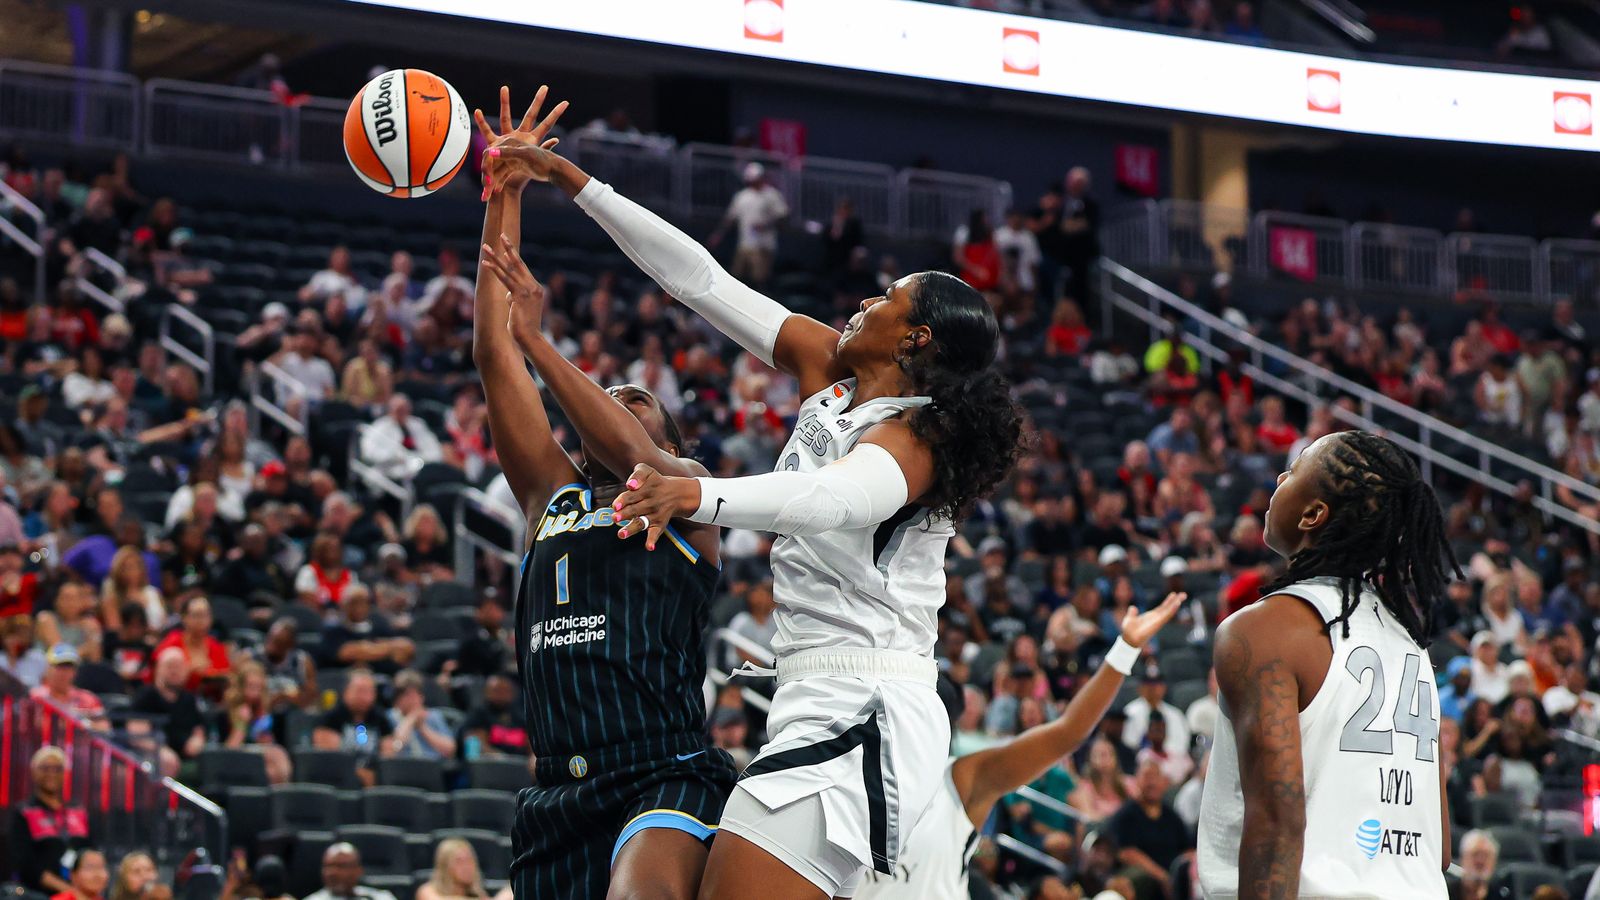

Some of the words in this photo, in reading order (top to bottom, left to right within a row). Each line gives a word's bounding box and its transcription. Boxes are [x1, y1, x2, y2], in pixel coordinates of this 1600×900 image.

[372, 72, 397, 148] Wilson
[836, 418, 854, 433] ally
[555, 552, 570, 605] 1
[543, 628, 606, 650] Medicine
[544, 614, 606, 633] UChicago
[1339, 645, 1438, 763] 24
[1378, 767, 1414, 806] LOYD
[1380, 829, 1422, 857] AT&T
